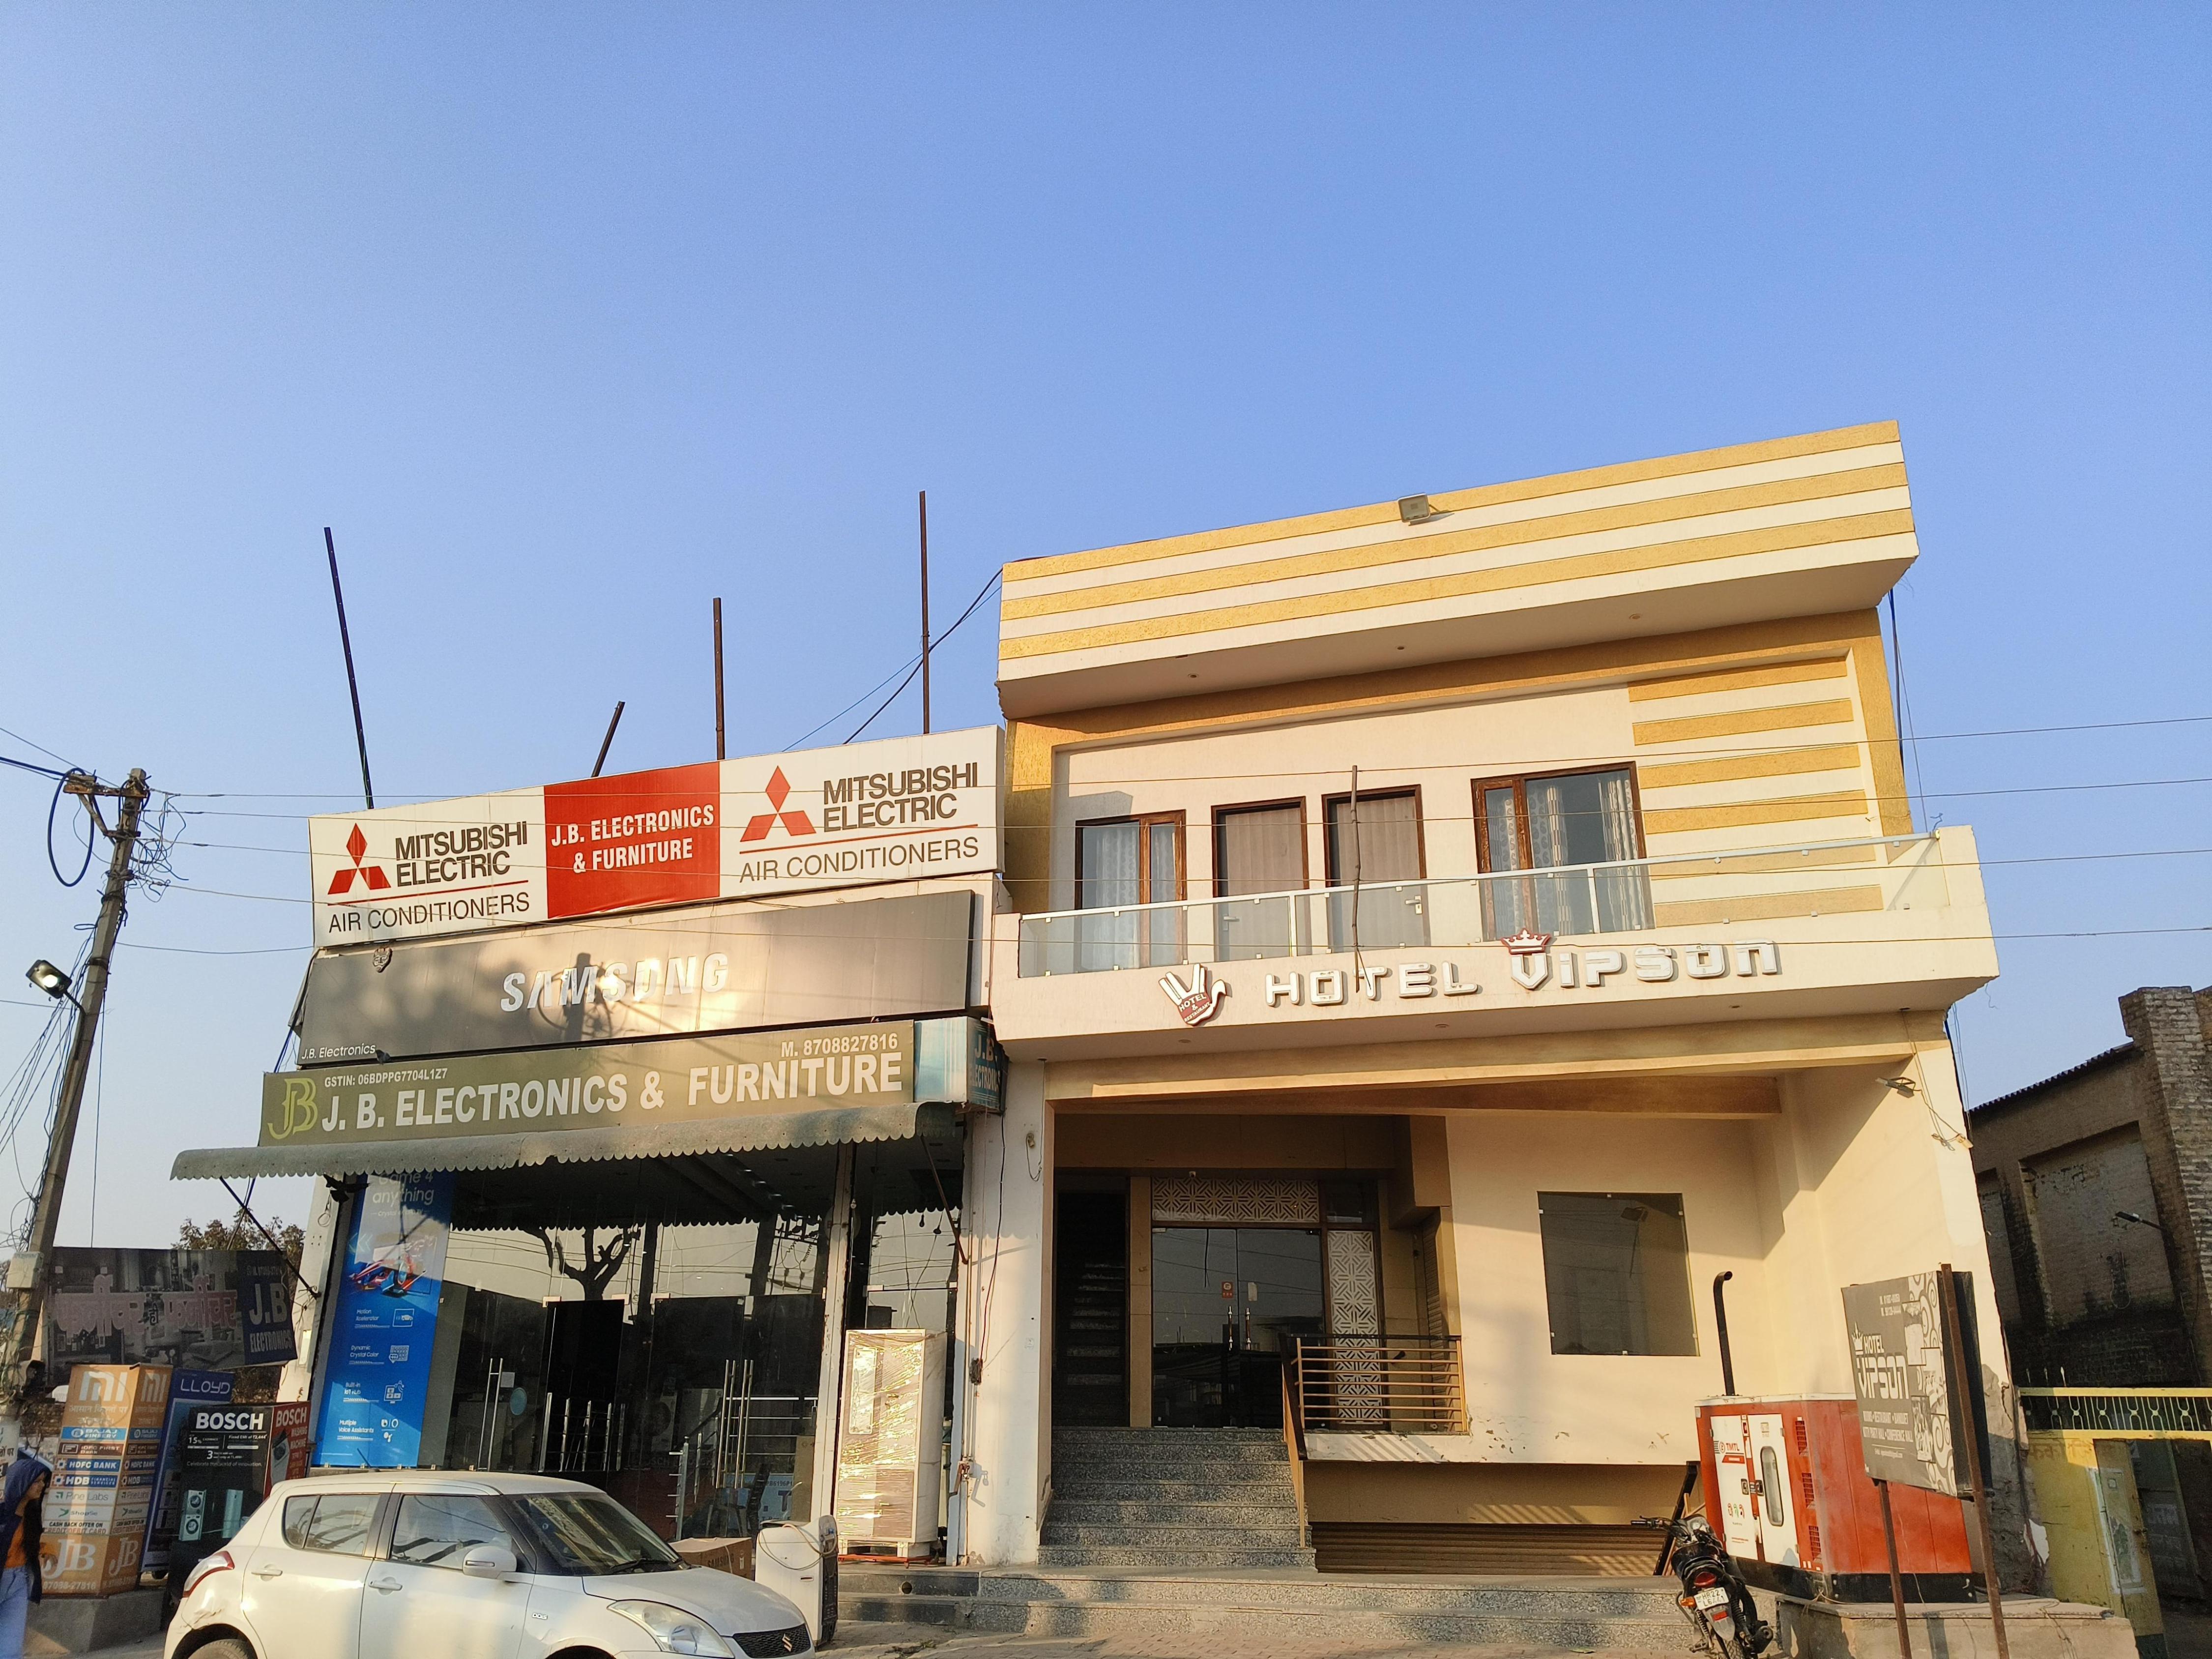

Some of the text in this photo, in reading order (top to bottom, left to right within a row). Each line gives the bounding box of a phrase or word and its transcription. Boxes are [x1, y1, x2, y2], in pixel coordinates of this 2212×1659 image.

[824, 762, 978, 805] MITSUBISHI
[824, 793, 957, 832] ELECTRIC
[551, 804, 714, 846] J.B. ELECTRONICS
[395, 821, 527, 860] MITSUBISHI
[573, 837, 693, 873] & FURNITURE
[739, 836, 978, 883] AIR CONDITIONERS
[397, 851, 510, 887] ELECTRIC
[328, 892, 529, 933] AIR CONDITIONERS
[500, 952, 728, 1012] SAMSUNG
[1266, 961, 1478, 1007] HOTEL
[1179, 993, 1207, 1012] HOTEL
[1184, 1002, 1211, 1022] RESTAURANT
[301, 1043, 376, 1059] J.B. Electronics
[781, 1033, 898, 1057] M. 8708827816
[324, 1068, 448, 1087] GSTIN: 06BDPPG7704L1Z7
[395, 1073, 627, 1126] ELECTRONICS
[640, 1071, 664, 1109] &
[688, 1052, 902, 1106] FURNITURE
[373, 1187, 434, 1207] anything
[249, 1283, 288, 1325] J.B
[250, 1329, 292, 1352] ELECTRONICS
[1863, 1335, 1885, 1354] HOTEL
[180, 1378, 231, 1394] LLOYD
[196, 1412, 264, 1430] BOSCH
[276, 1407, 307, 1427] BOSCH
[206, 1450, 213, 1459] 3
[1726, 1443, 1740, 1451] TMTL
[128, 1476, 141, 1484] HDB
[66, 1491, 109, 1501] Pine Labs
[1701, 1590, 1720, 1600] HR22
